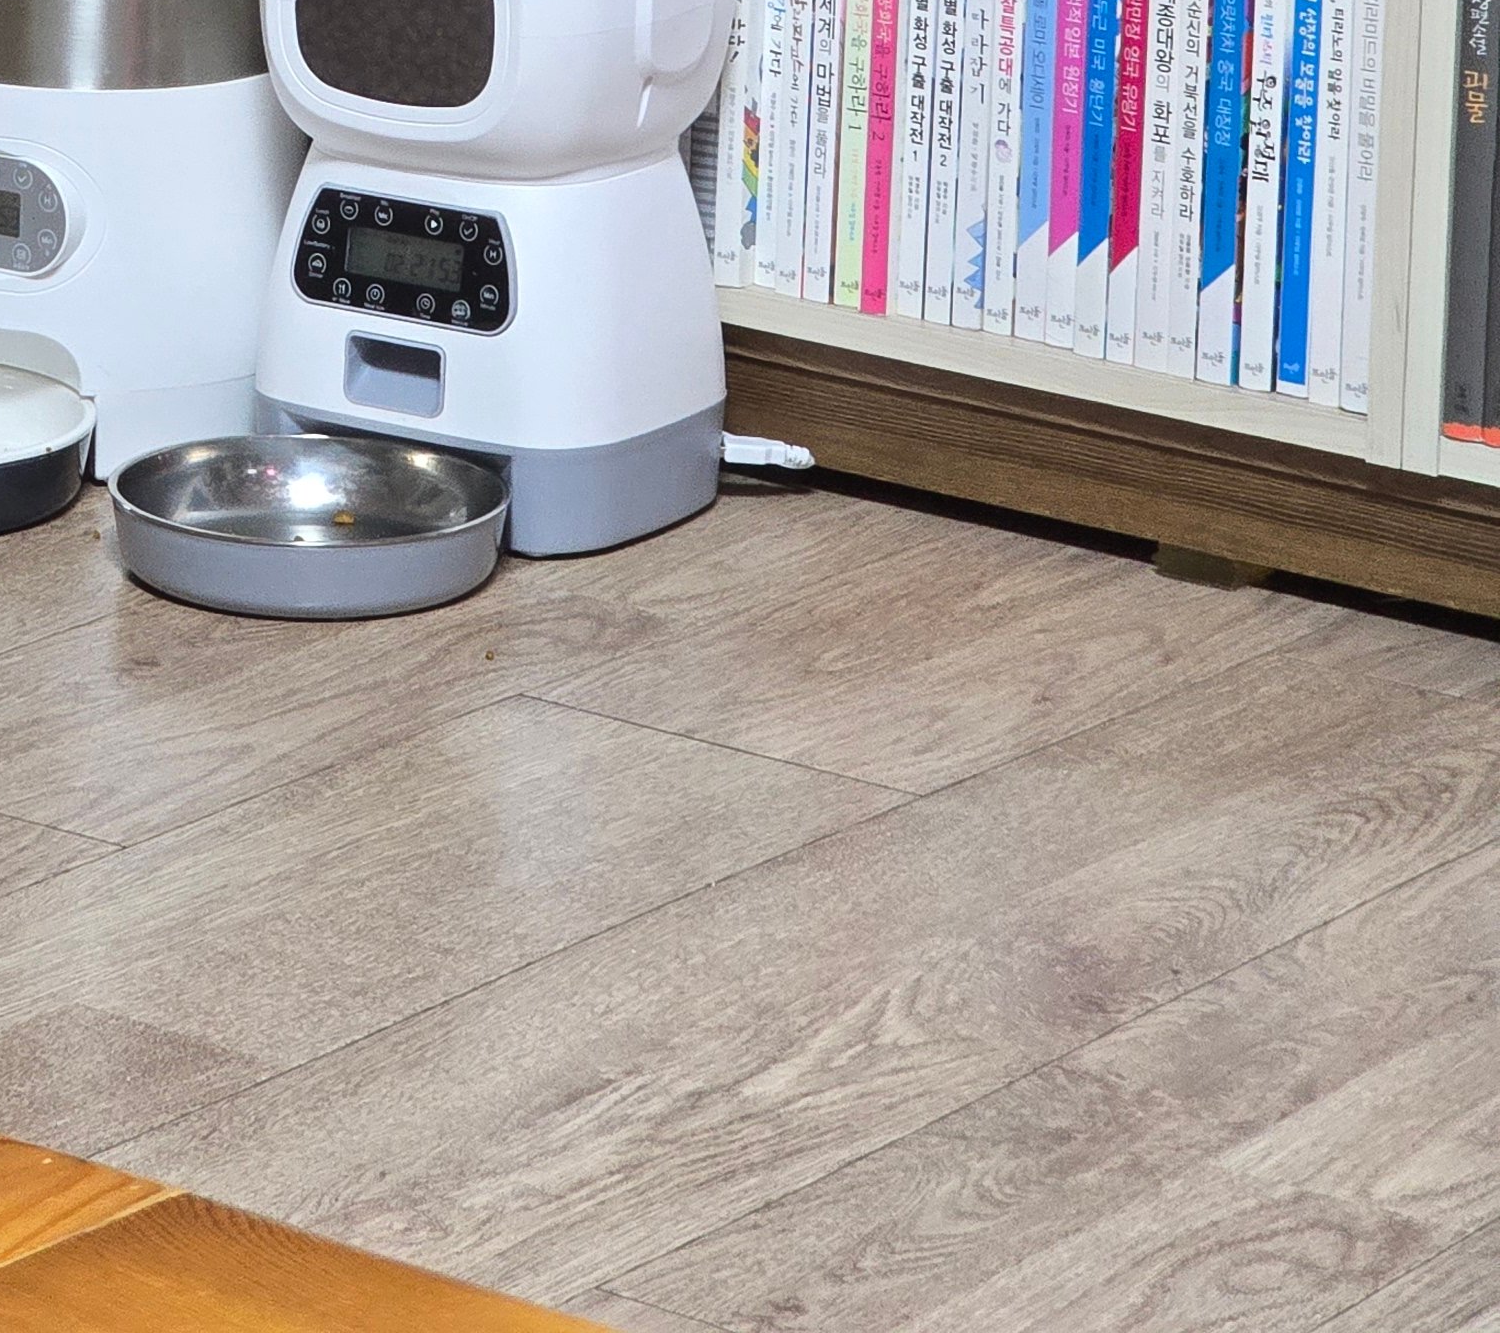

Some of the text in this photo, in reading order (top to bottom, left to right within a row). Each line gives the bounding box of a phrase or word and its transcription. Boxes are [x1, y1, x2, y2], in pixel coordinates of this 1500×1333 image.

[911, 15, 930, 51] 화성
[1063, 22, 1081, 57] 일본
[910, 55, 927, 87] 구출
[1091, 38, 1107, 69] 미국
[1295, 64, 1315, 116] 보물을
[1359, 73, 1377, 129] 비밀을
[908, 94, 926, 145] 대작전
[996, 102, 1013, 137] 가다
[1327, 97, 1342, 141] 찾아라
[1356, 134, 1374, 183] 풀어라
